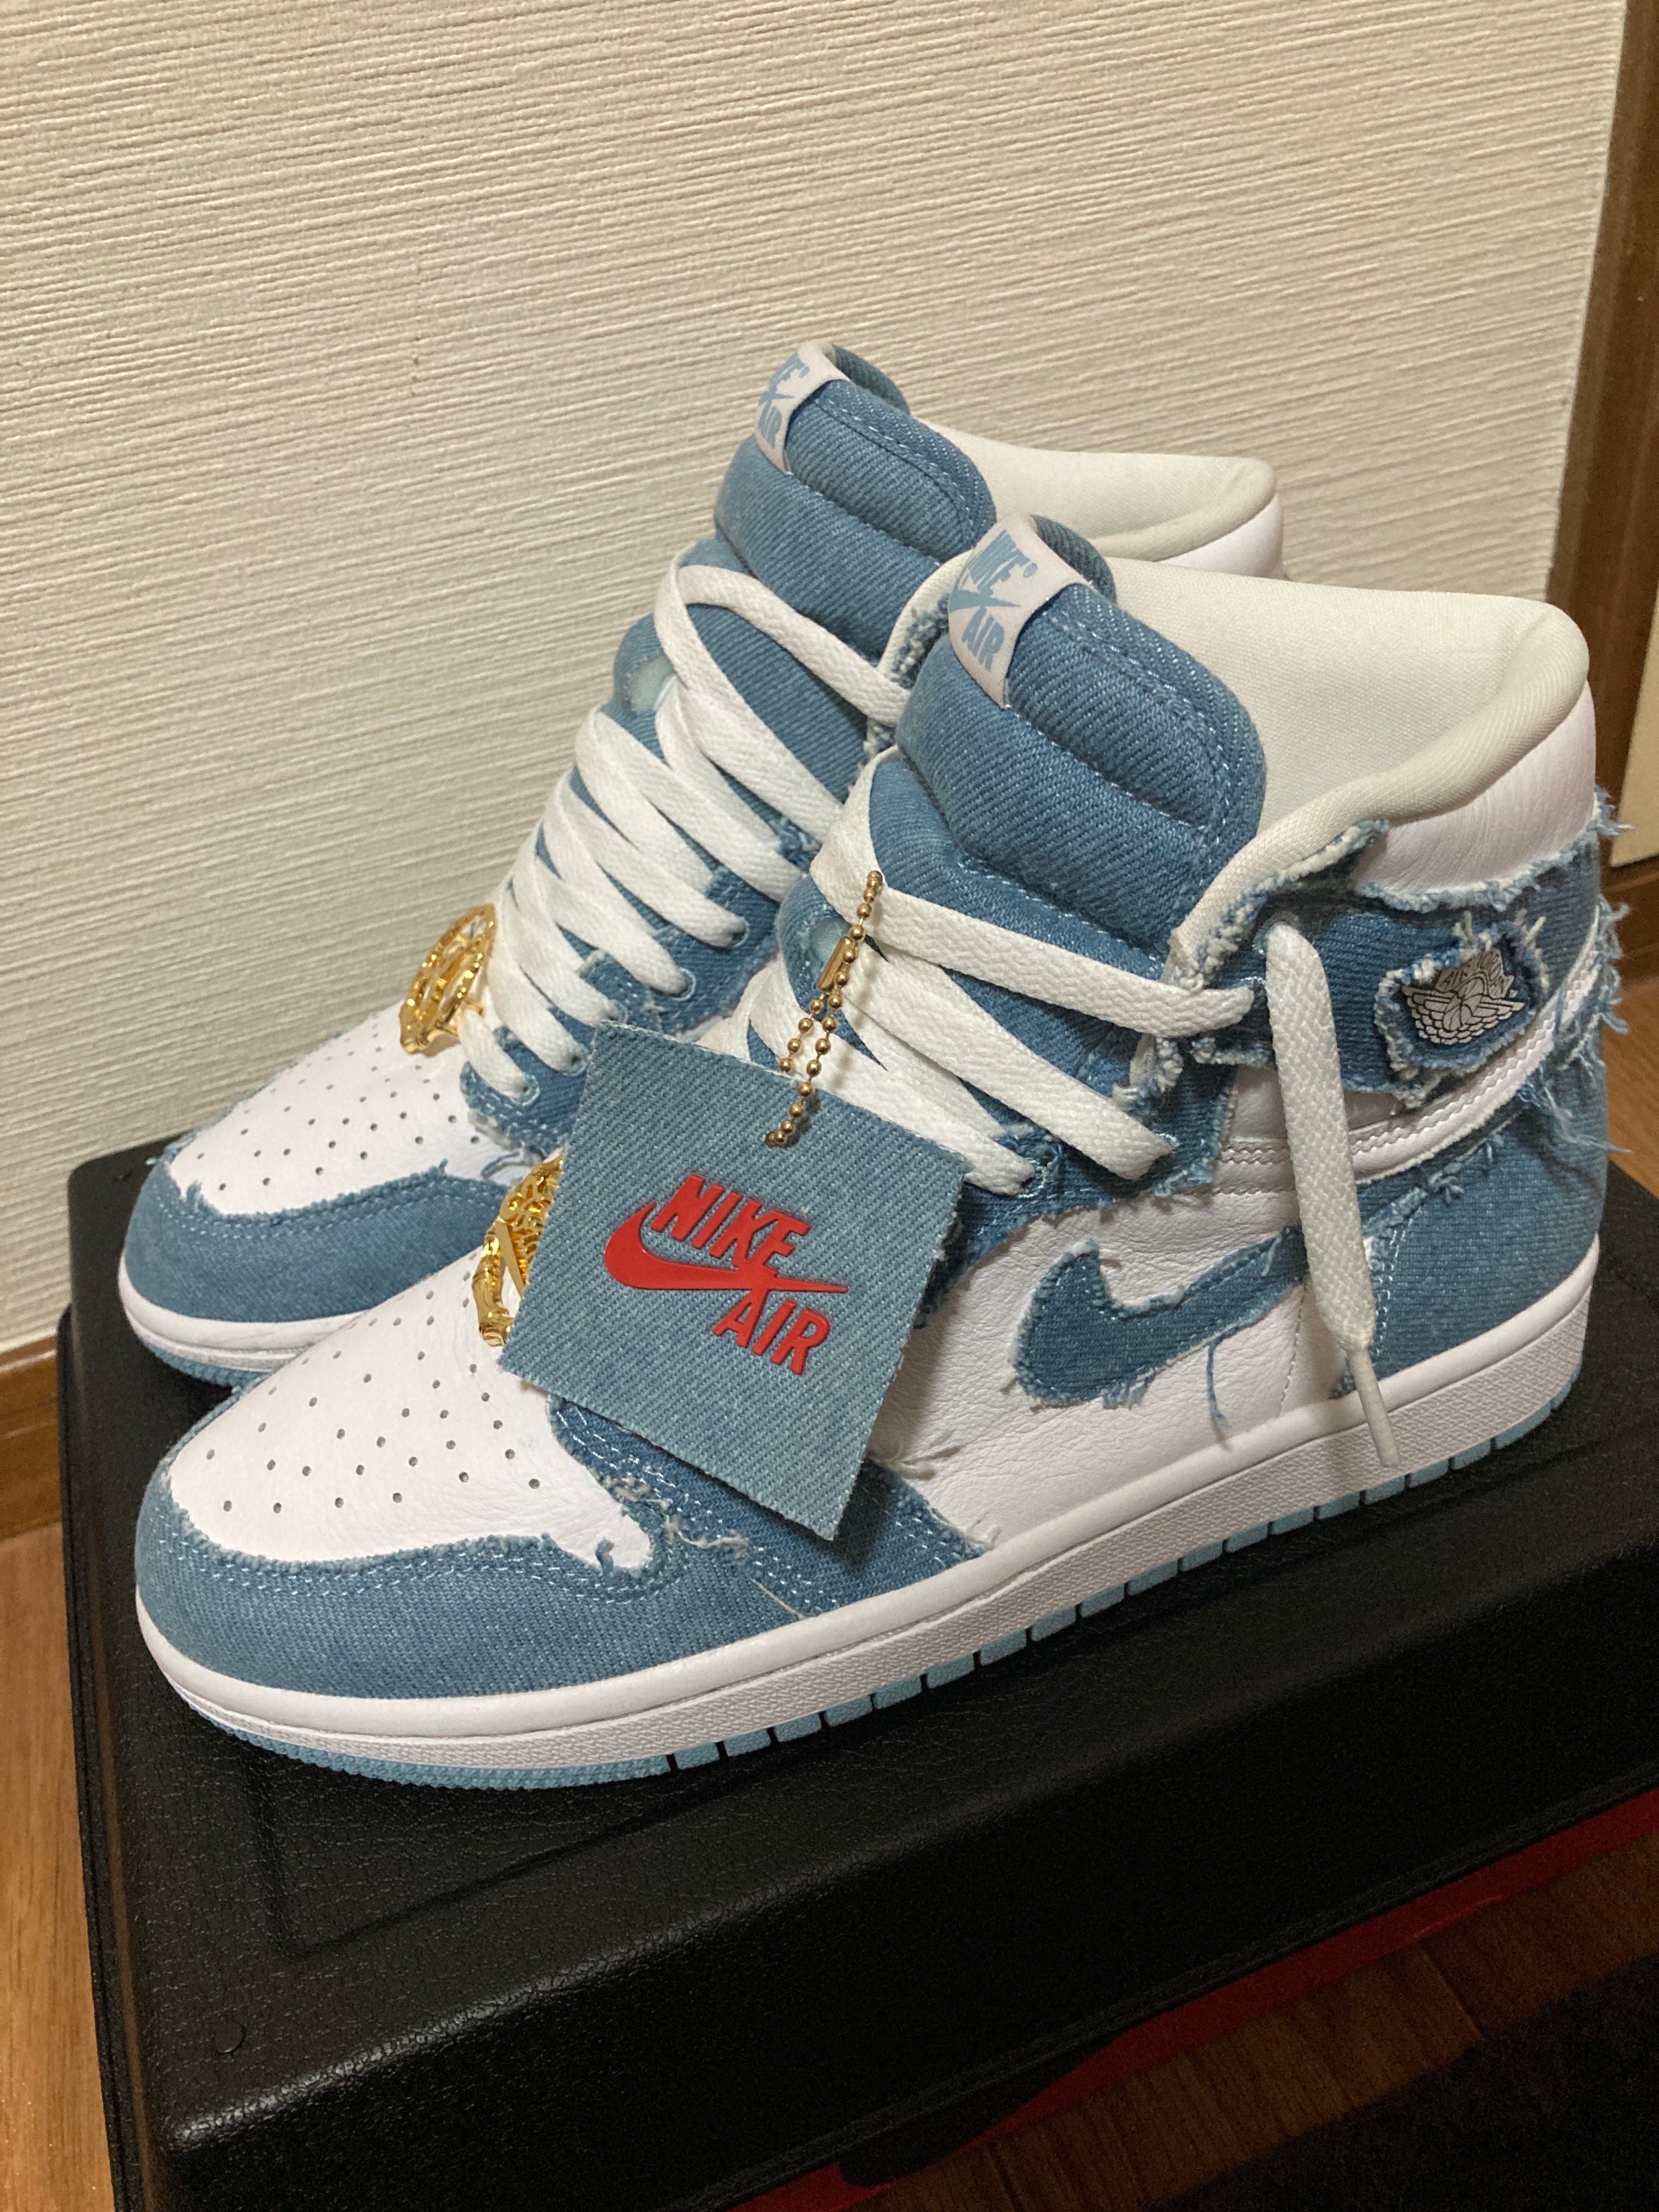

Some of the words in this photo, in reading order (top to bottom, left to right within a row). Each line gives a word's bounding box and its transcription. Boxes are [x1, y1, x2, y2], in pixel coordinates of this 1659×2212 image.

[961, 607, 1005, 672] AIR
[650, 1173, 812, 1275] NIKE
[711, 1289, 831, 1376] AIR
